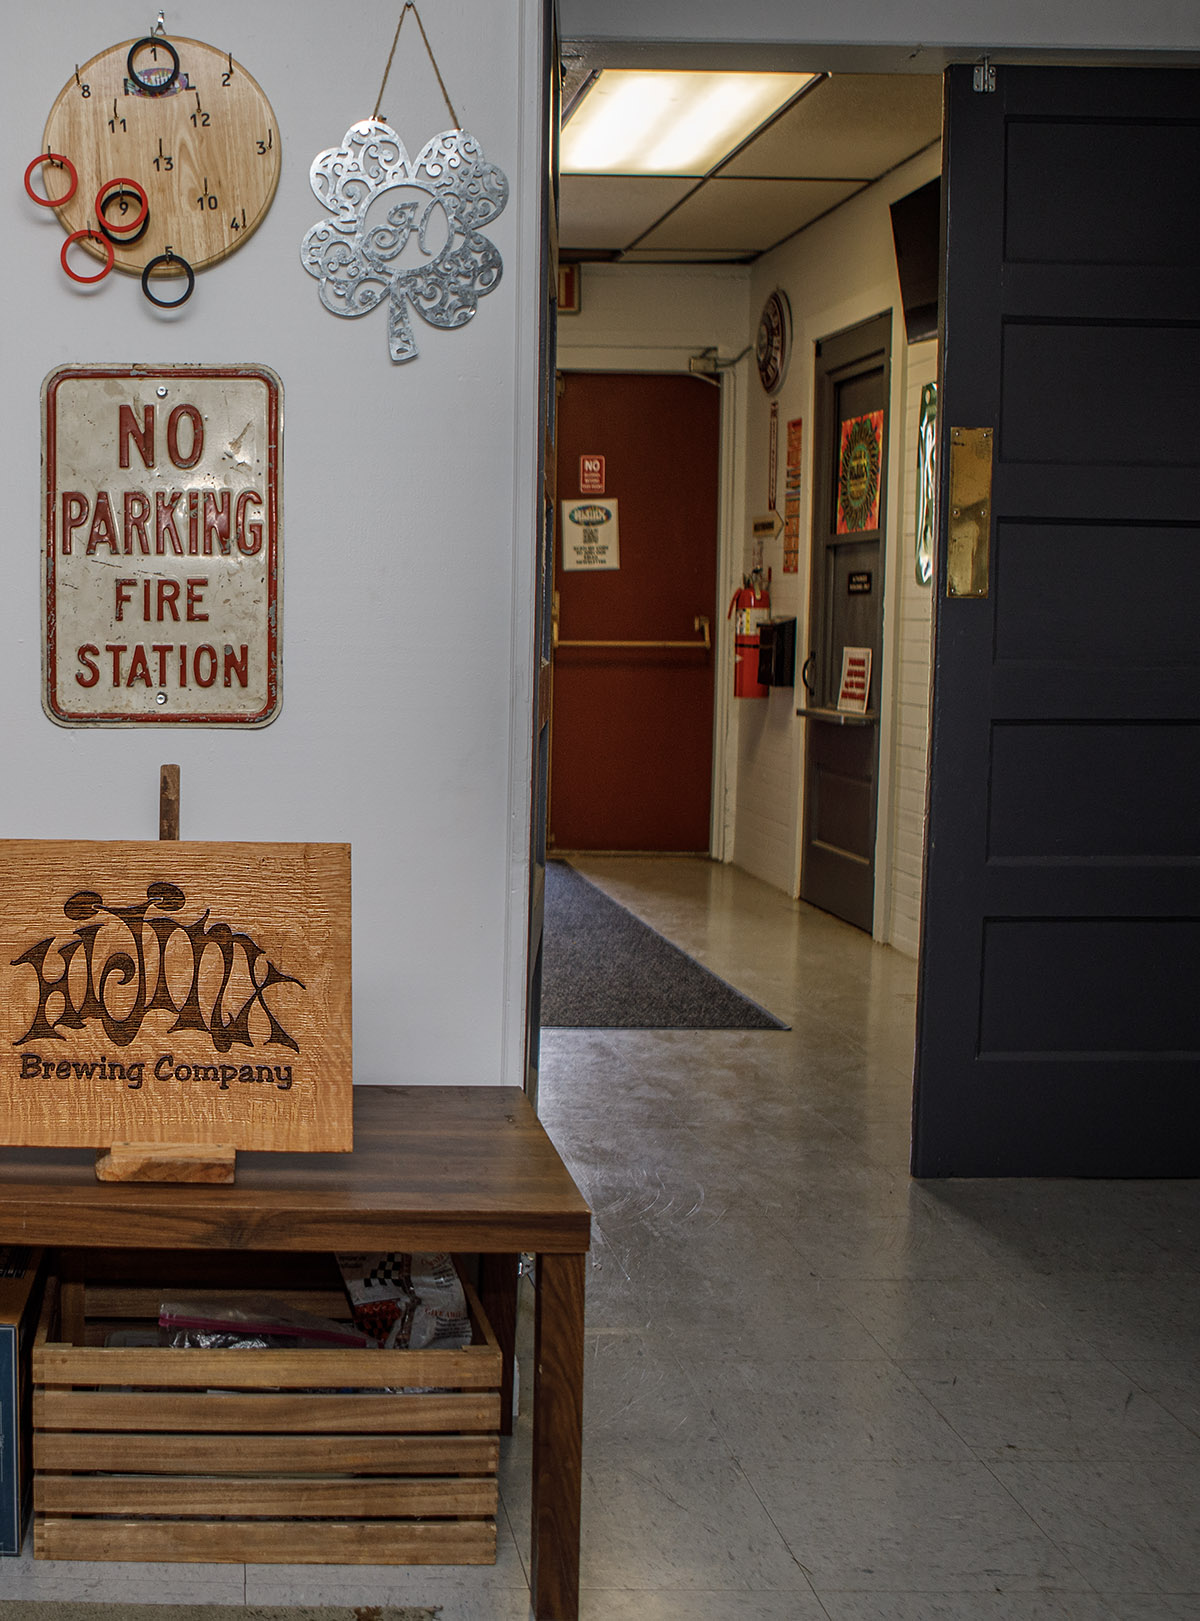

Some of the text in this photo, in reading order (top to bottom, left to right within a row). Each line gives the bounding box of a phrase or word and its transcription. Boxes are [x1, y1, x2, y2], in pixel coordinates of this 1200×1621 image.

[150, 47, 157, 61] 1
[222, 73, 231, 86] 2
[81, 85, 91, 98] 8
[108, 119, 127, 133] 11
[190, 113, 210, 127] 12
[256, 141, 266, 155] 3
[153, 157, 174, 172] 13
[119, 202, 129, 216] 9
[197, 196, 218, 211] 10
[230, 217, 240, 231] 4
[119, 404, 204, 469] NO
[585, 460, 600, 472] NO
[62, 491, 263, 555] PARKING
[115, 579, 209, 622] FIRE
[75, 644, 248, 688] STATION
[20, 1053, 292, 1090] Brewing Company
